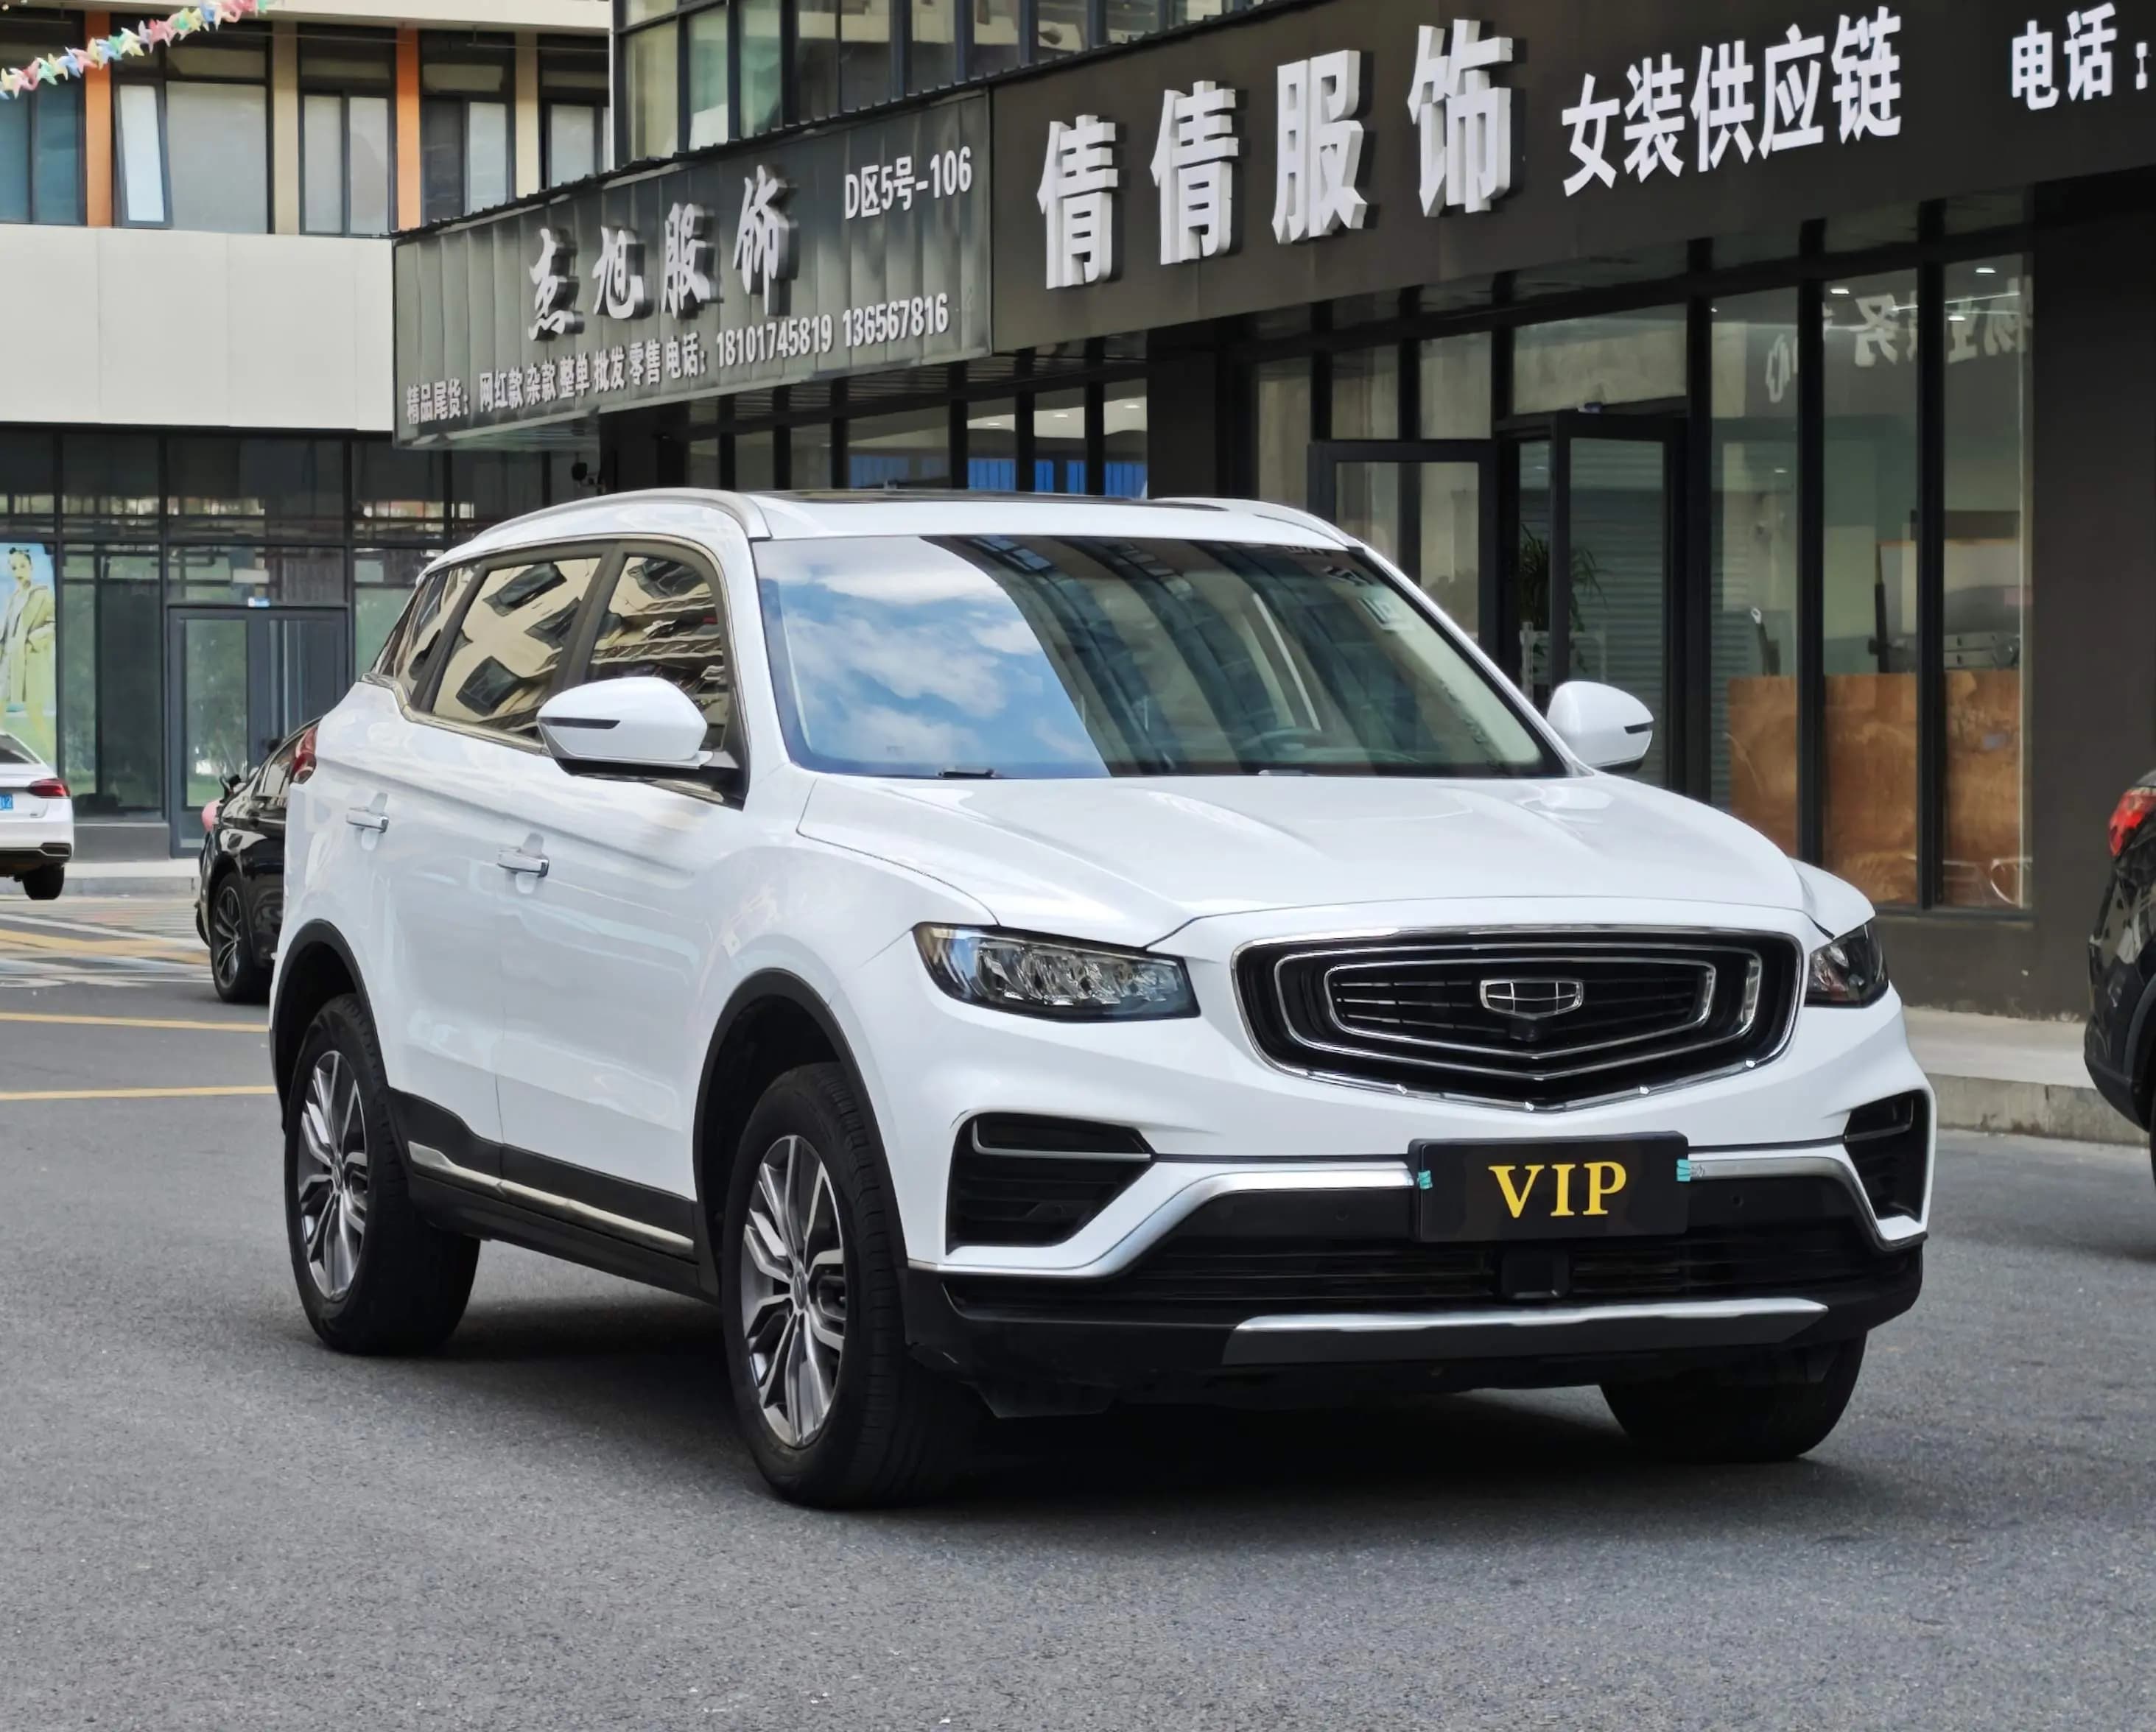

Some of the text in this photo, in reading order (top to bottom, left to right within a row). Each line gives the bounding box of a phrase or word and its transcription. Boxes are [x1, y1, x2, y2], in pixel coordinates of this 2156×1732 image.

[1562, 5, 1902, 197] 女装供应链
[845, 146, 972, 220] D区5号-106
[1036, 18, 1514, 290] 倩倩服饰
[716, 314, 833, 368] 18101745819
[842, 292, 949, 348] 136567816
[1488, 1161, 1627, 1219] VIP
